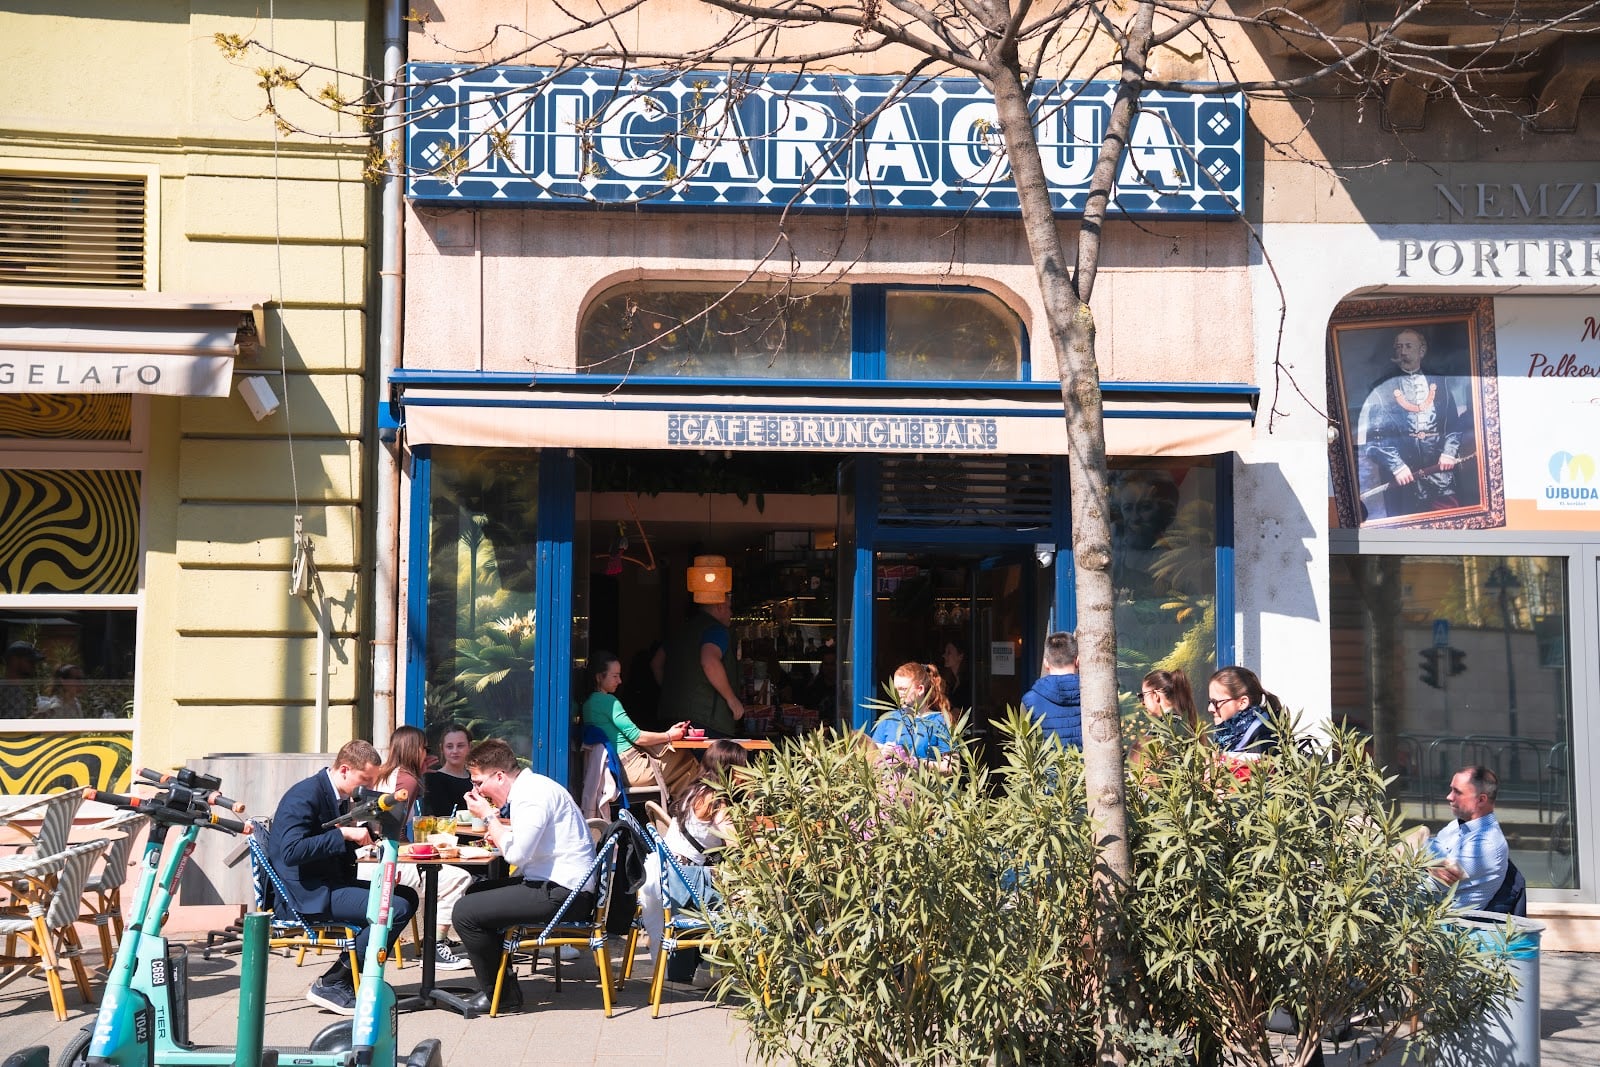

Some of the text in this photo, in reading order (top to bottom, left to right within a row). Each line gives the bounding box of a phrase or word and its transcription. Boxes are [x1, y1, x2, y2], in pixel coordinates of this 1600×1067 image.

[467, 89, 1192, 187] NICARAGUA
[0, 363, 161, 386] GELATO
[682, 419, 987, 445] CAFE BRUNCH BAR
[1545, 485, 1599, 499] ÚJBUDA
[151, 960, 165, 985] C669
[94, 994, 118, 1045] dott
[135, 1012, 147, 1041] Y042
[157, 1005, 166, 1039] TIER
[356, 988, 377, 1036] dott
